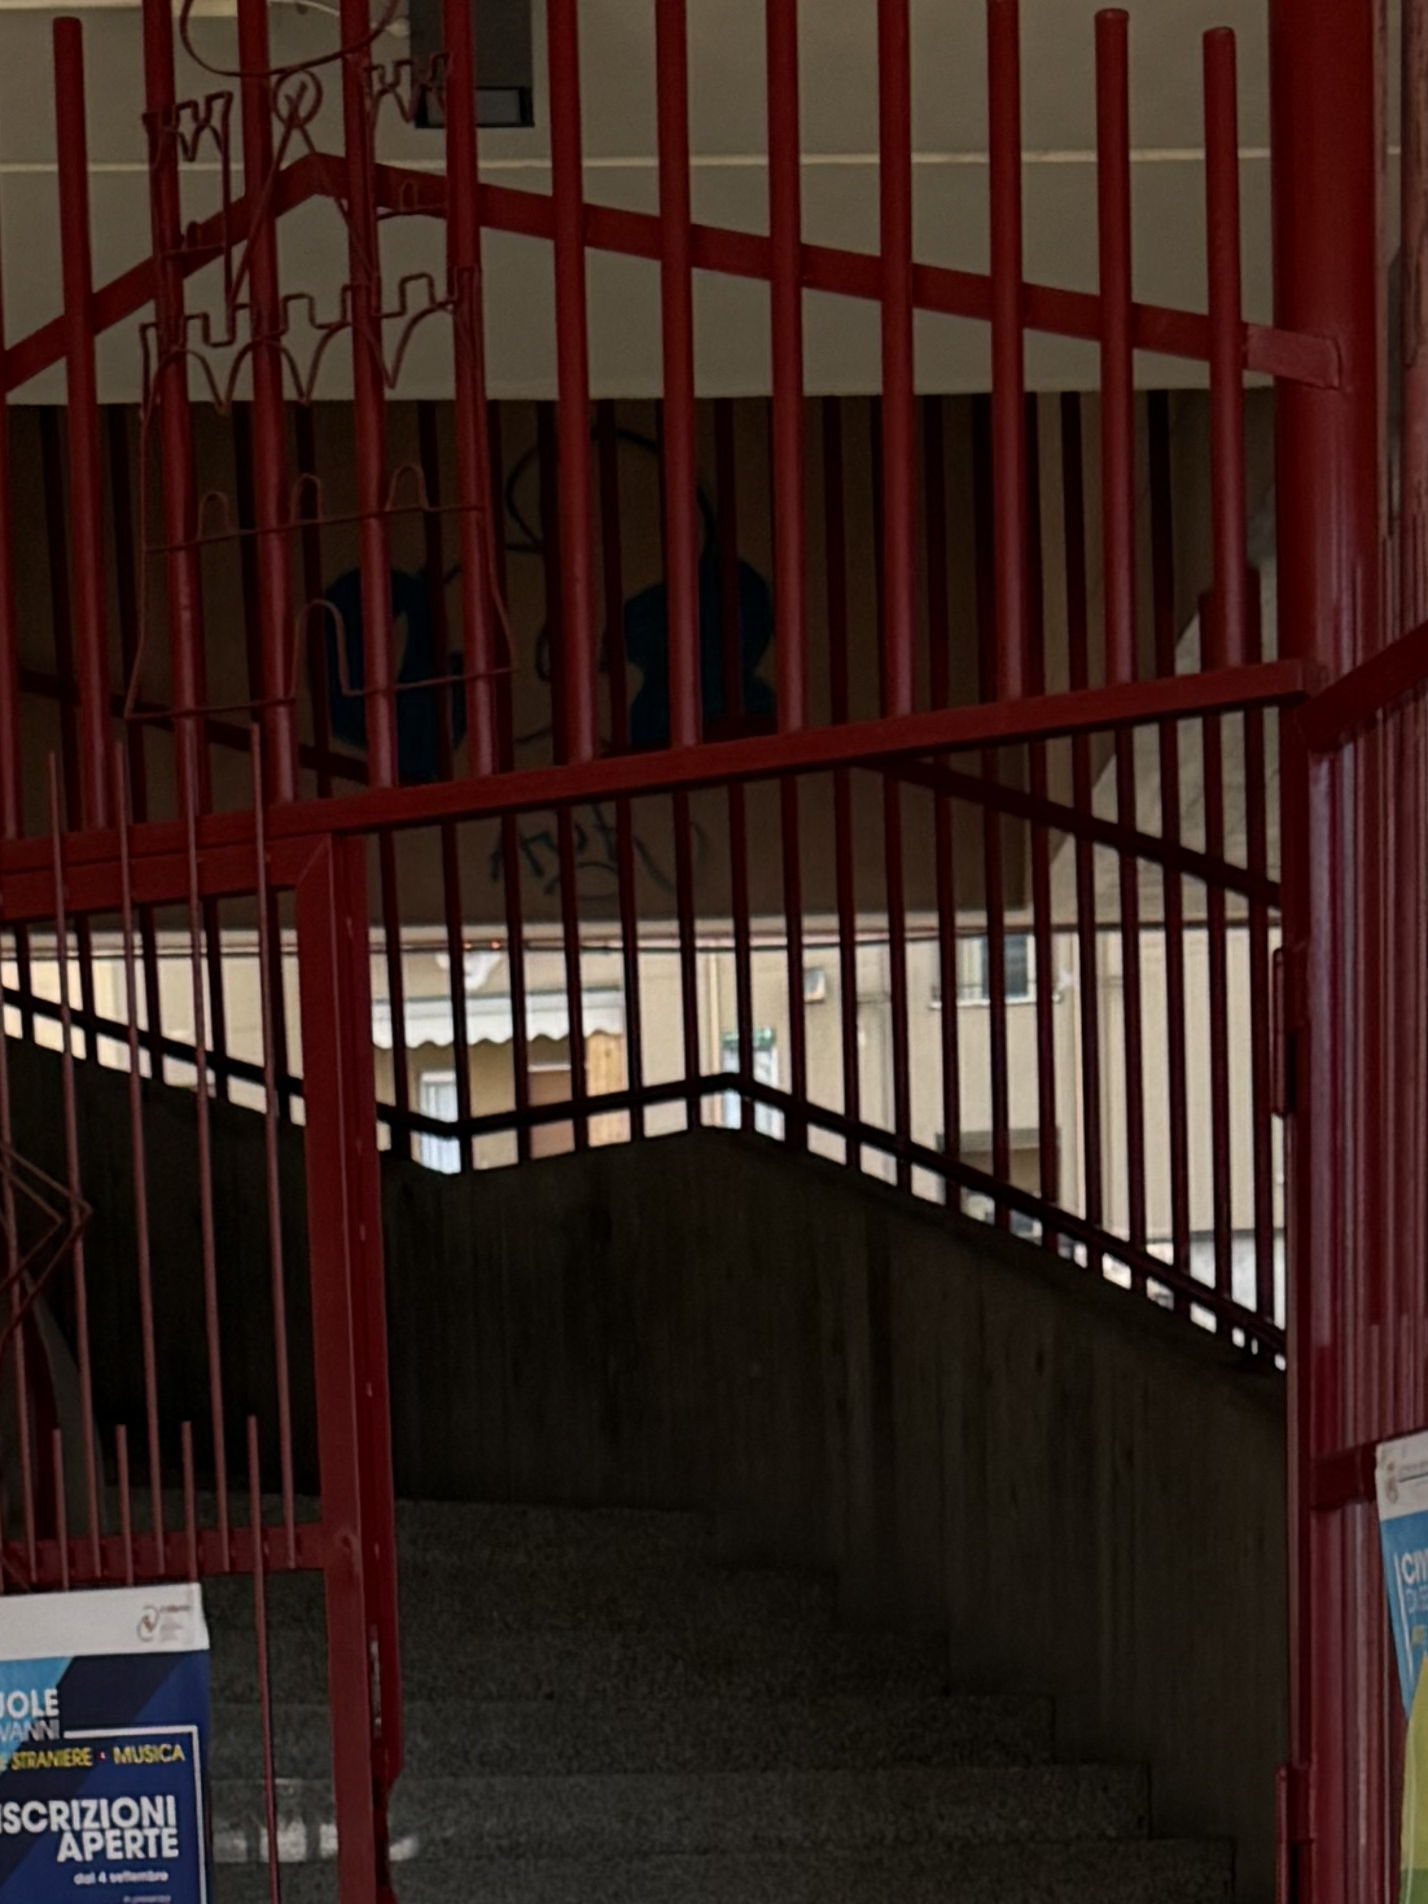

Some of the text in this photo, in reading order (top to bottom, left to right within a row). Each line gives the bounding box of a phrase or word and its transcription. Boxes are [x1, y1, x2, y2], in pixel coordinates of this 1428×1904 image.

[11, 1744, 185, 1771] STRANIERE MUSICA
[57, 1829, 178, 1863] APERTE
